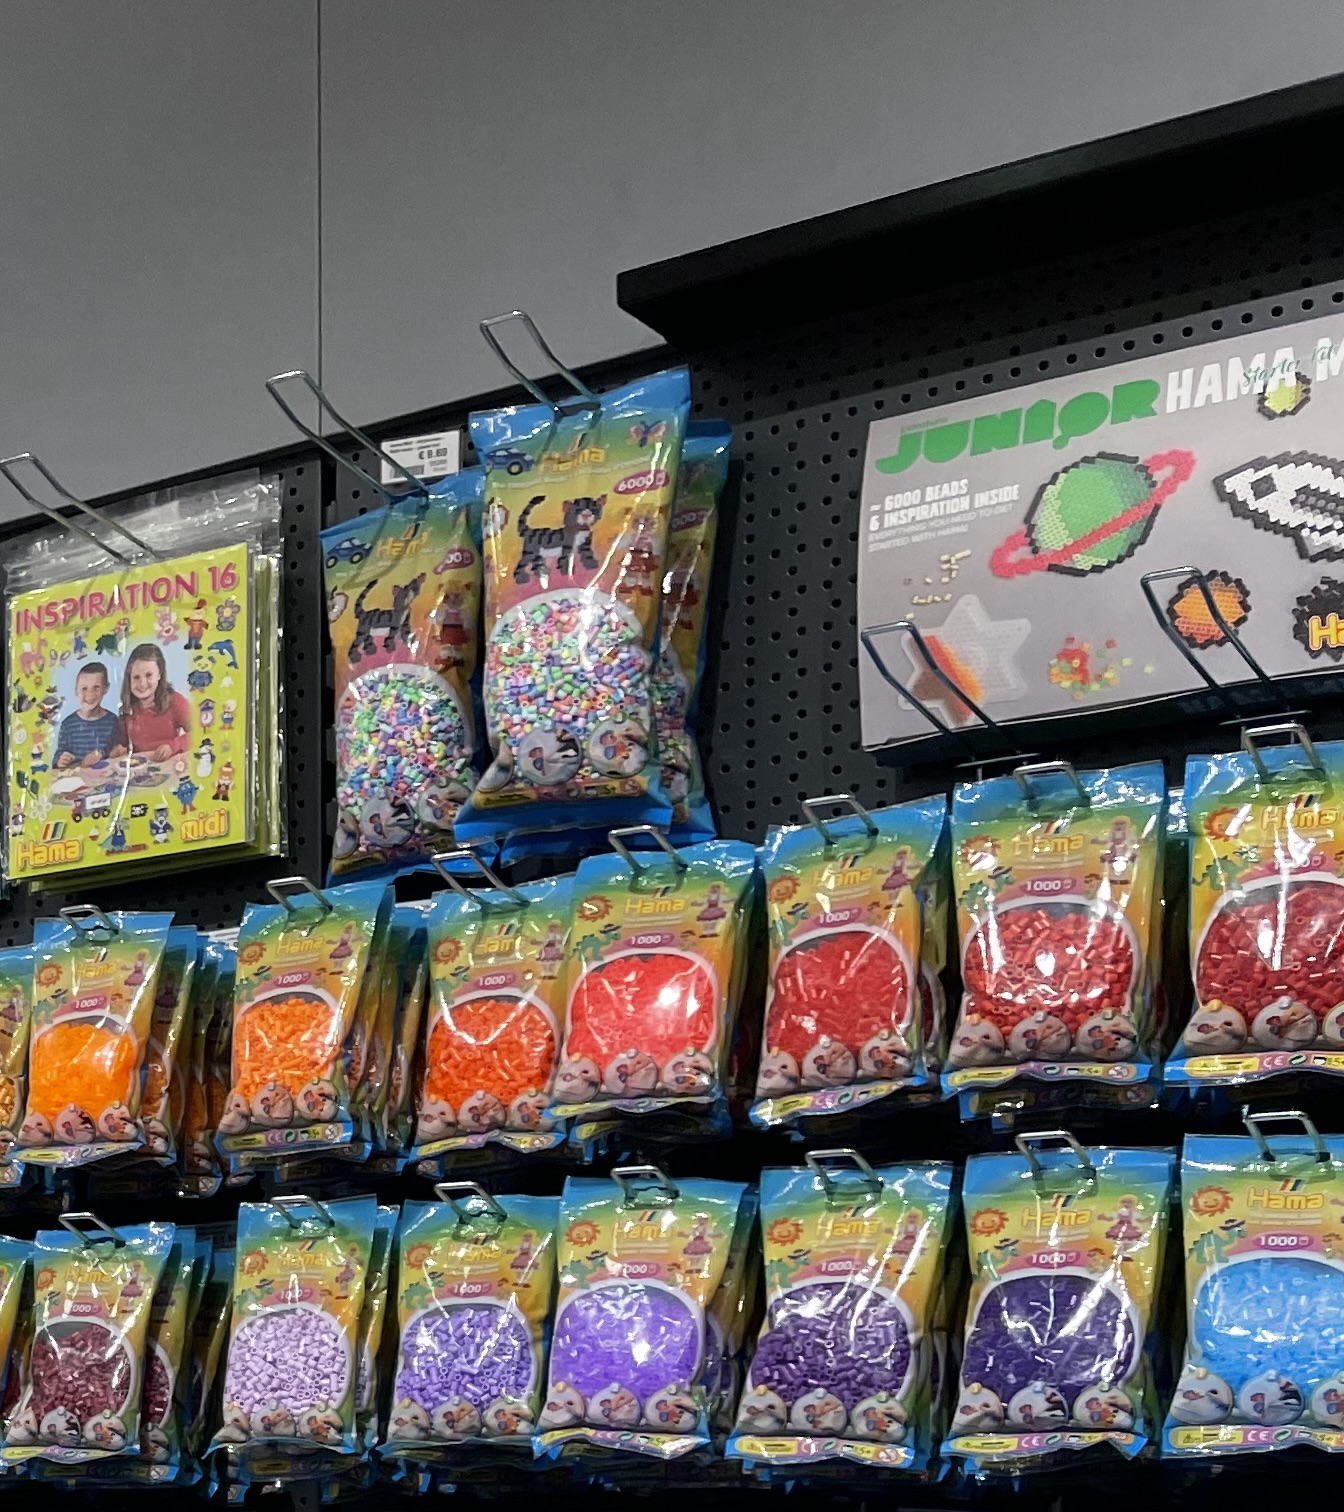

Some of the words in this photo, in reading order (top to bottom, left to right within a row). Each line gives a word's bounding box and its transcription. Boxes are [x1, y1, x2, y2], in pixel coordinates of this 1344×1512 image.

[875, 379, 1161, 474] JUNIOR
[1166, 346, 1296, 413] HAMA
[885, 488, 922, 509] 6000
[925, 479, 968, 499] BEADS
[883, 495, 970, 528] INSPIRATION
[974, 485, 1020, 508] INSIDE
[15, 569, 197, 634] INSPIRATION
[208, 563, 238, 590] 16
[181, 811, 227, 840] midi
[15, 837, 81, 870] Hama
[1013, 833, 1083, 853] Hama
[1025, 878, 1063, 892] 1000
[625, 897, 684, 915] Hama
[630, 933, 663, 946] 1000
[1248, 1187, 1324, 1210] Hama
[1021, 1207, 1092, 1229] Hama
[1260, 1234, 1298, 1248] 1000
